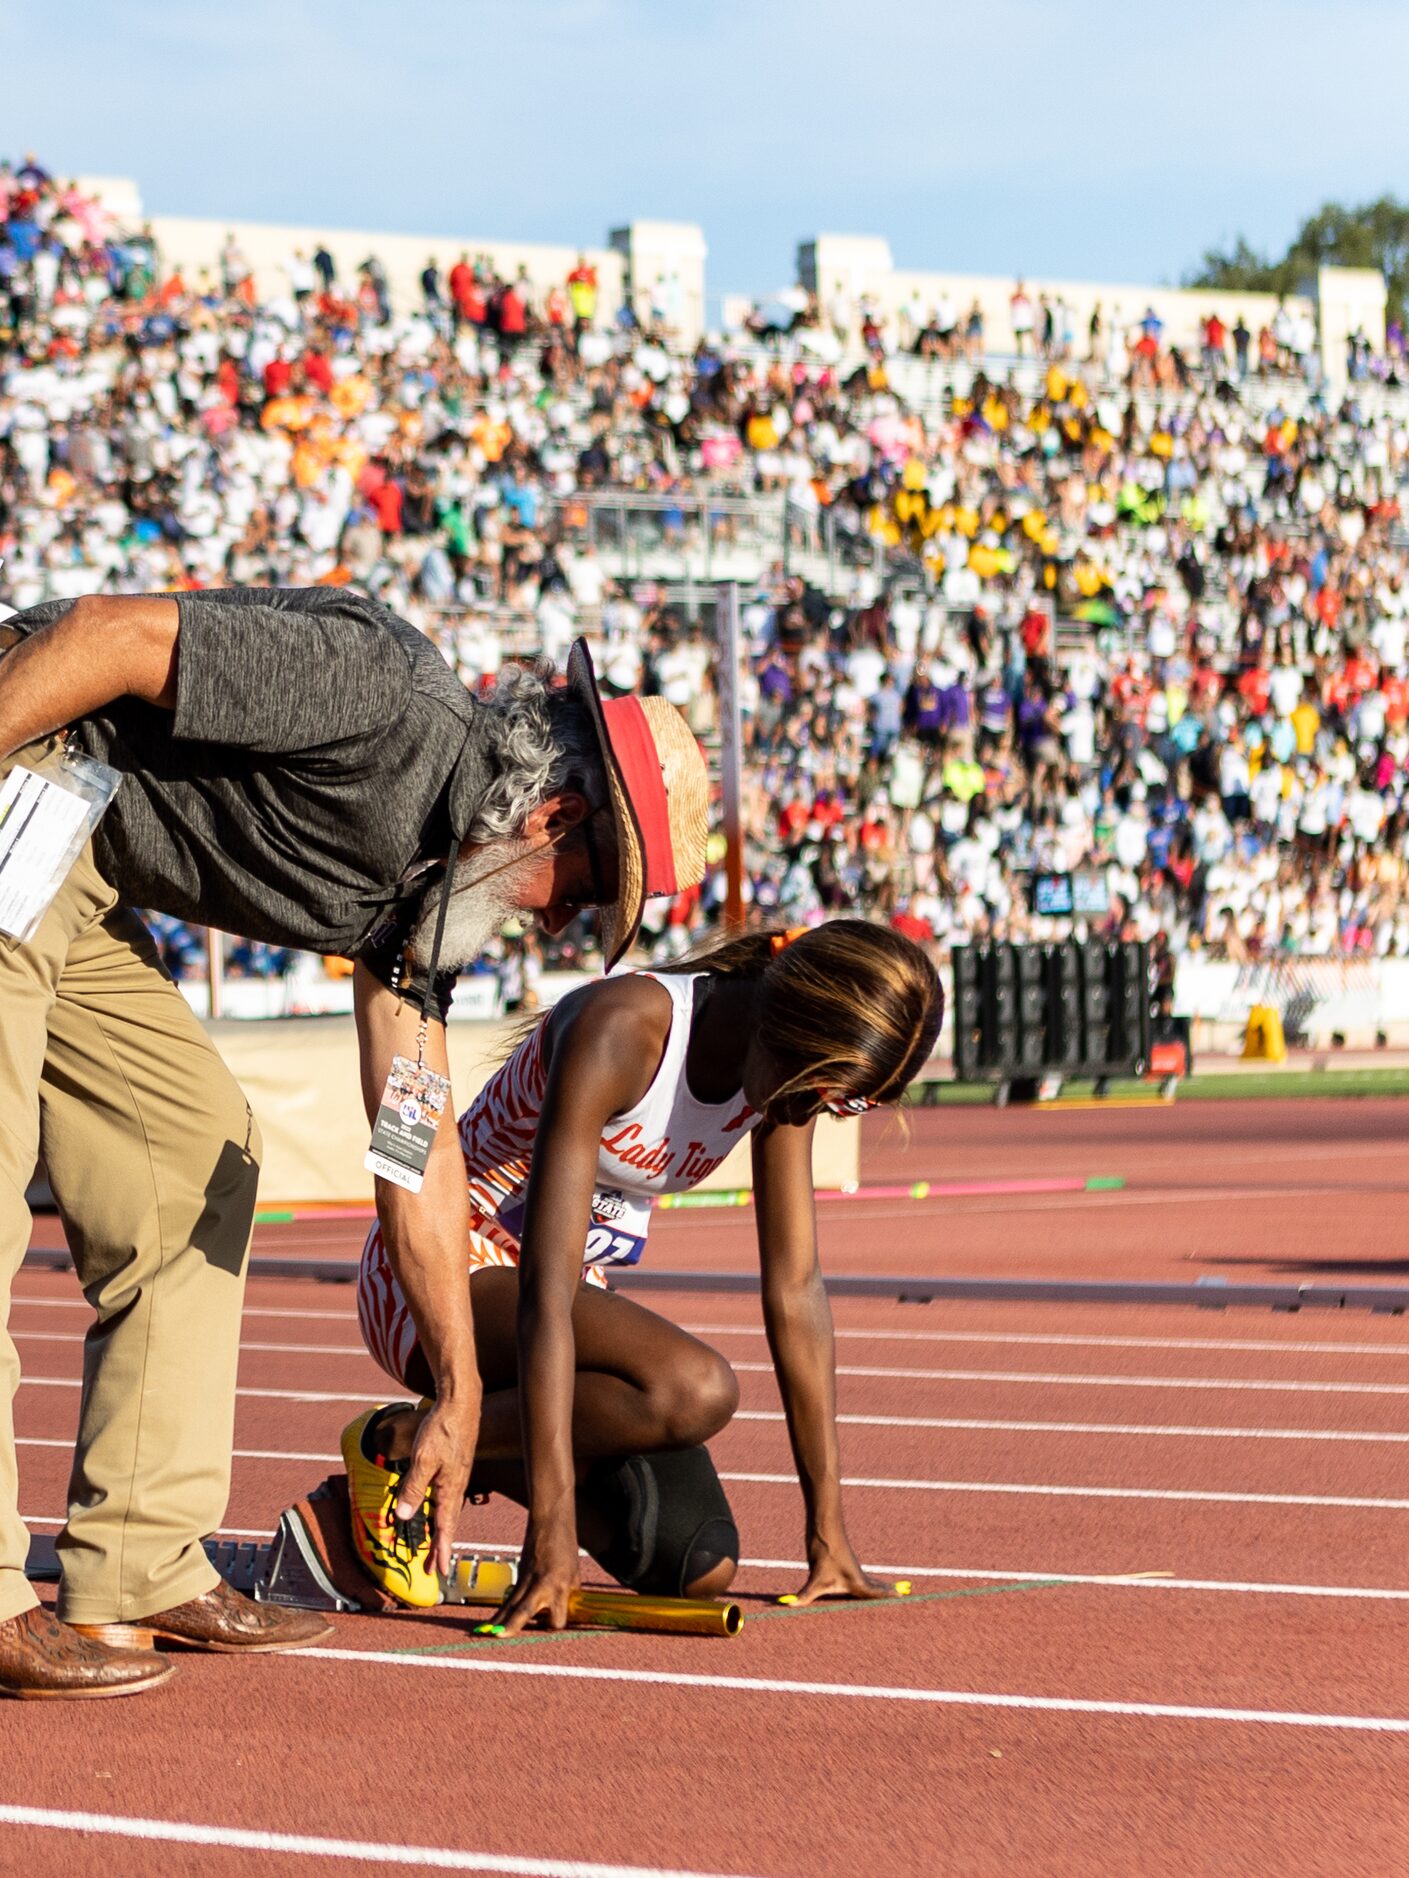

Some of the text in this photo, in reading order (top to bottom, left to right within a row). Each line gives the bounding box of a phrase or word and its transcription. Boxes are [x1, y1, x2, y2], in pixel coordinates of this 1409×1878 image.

[380, 1120, 429, 1148] TRACK AND FIELD
[600, 1123, 675, 1180] Lady
[375, 1161, 411, 1184] OFFICIAL
[592, 1197, 626, 1220] STATE
